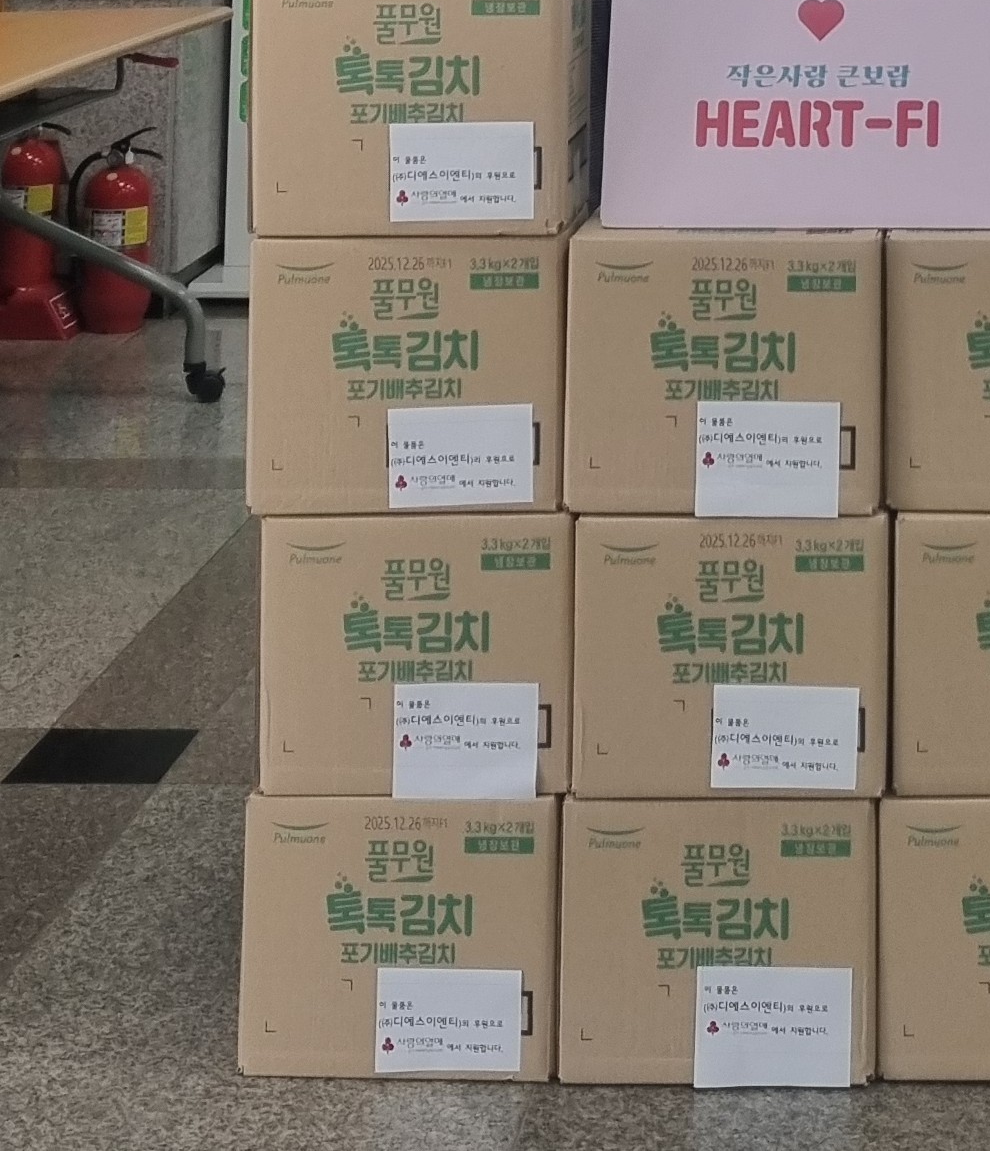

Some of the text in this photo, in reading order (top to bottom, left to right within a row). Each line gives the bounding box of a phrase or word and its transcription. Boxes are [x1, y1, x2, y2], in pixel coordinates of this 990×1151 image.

[281, 0, 333, 9] Pulmuone
[374, 3, 442, 45] 풀무원
[335, 53, 480, 96] 톡톡김치
[726, 64, 910, 88] 작은사랑 큰보람
[350, 103, 464, 124] 포기배추김치
[695, 100, 939, 147] HEART-FI
[278, 274, 331, 285] Pulmuone
[370, 277, 439, 320] 풀무원
[598, 272, 649, 283] Pulmuone
[689, 278, 757, 321] 풀무원
[332, 329, 479, 372] 톡톡김치
[650, 328, 796, 373] 톡톡김치
[347, 378, 462, 400] 포기배추김치
[665, 379, 779, 401] 포기배추김치
[289, 553, 342, 565] Pulmuone
[381, 558, 450, 601] 풀무원
[604, 554, 656, 566] Pulmuone
[695, 559, 764, 602] 풀무원
[343, 609, 490, 653] 톡톡김치
[657, 612, 804, 655] 톡톡김치
[358, 660, 473, 682] 포기배추김치
[672, 661, 787, 684] 포기배추김치
[273, 832, 325, 845] Pulmuone
[365, 839, 433, 882] 풀무원
[681, 843, 749, 887] 풀무원
[326, 891, 472, 936] 톡톡김치
[642, 895, 789, 940] 톡톡김치
[341, 943, 455, 964] 포기배추김치
